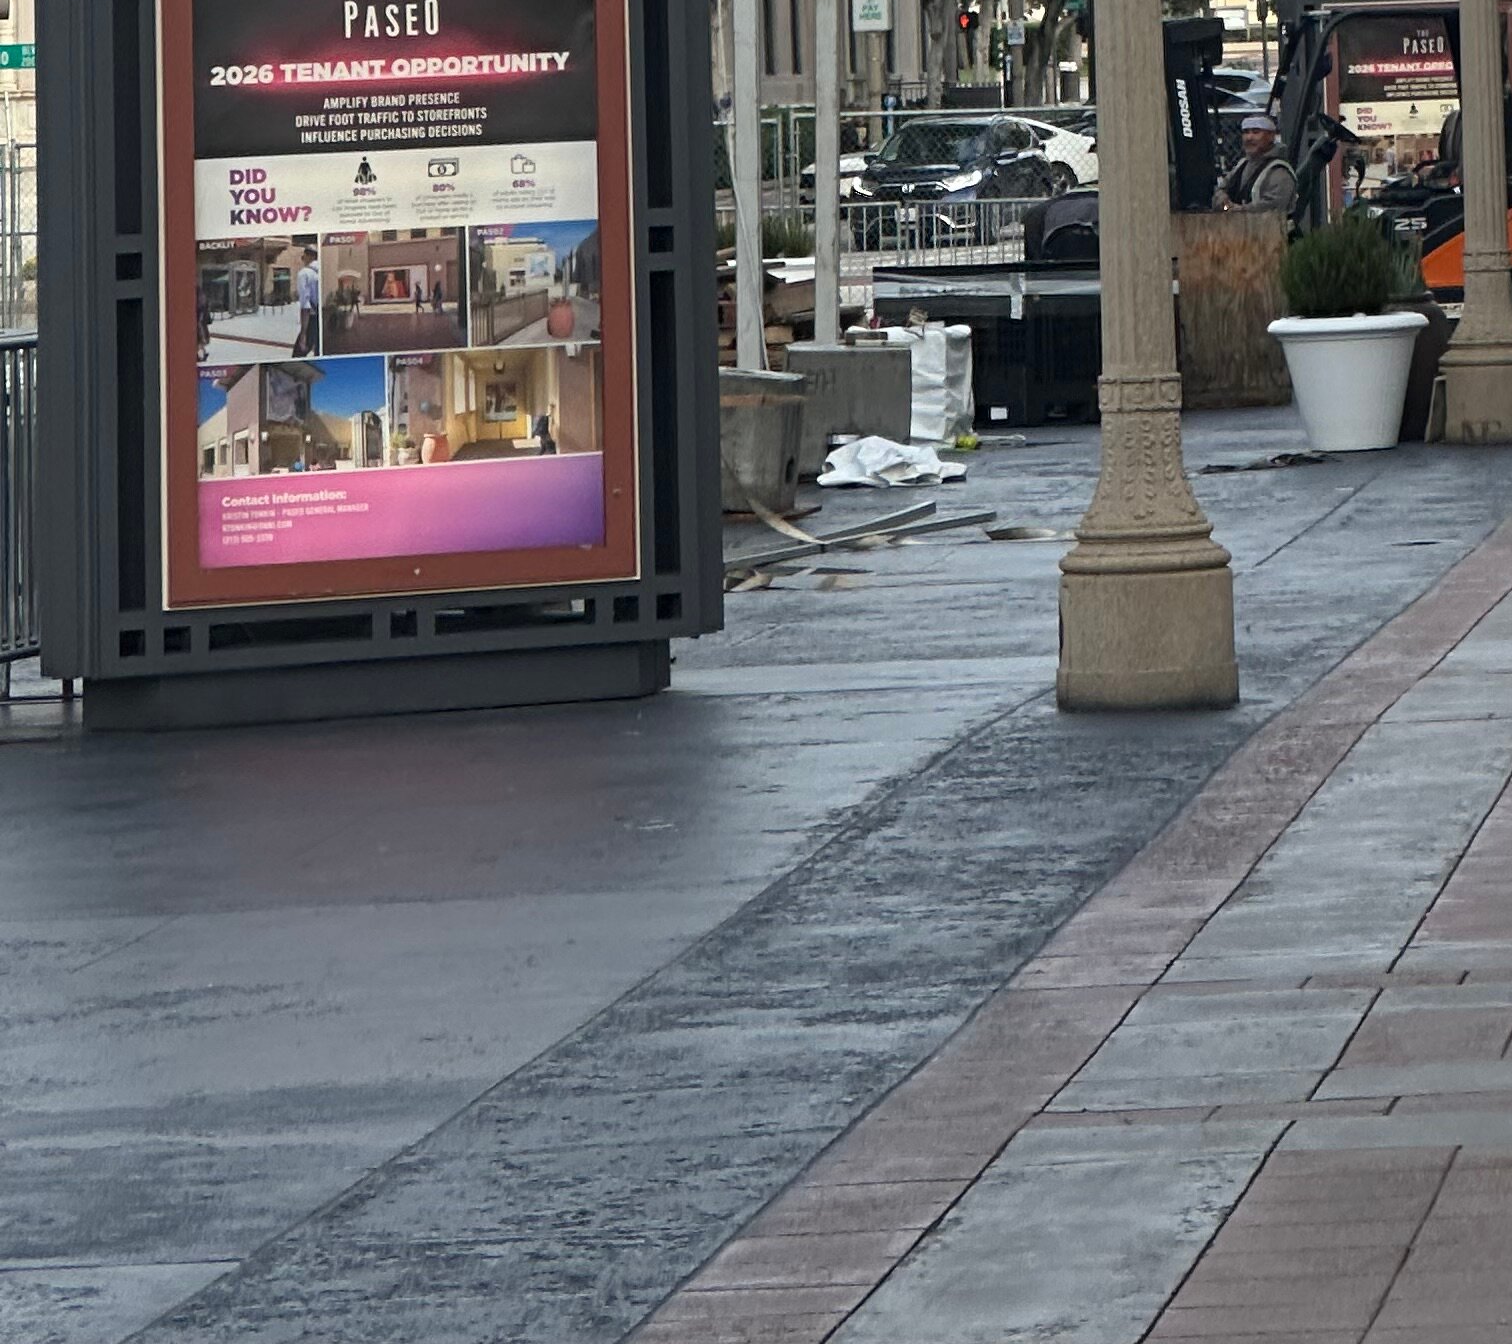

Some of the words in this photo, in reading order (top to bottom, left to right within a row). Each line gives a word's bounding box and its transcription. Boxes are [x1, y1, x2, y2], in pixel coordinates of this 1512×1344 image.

[1403, 36, 1444, 54] PASEO
[210, 64, 274, 86] 2026
[279, 59, 386, 83] TENANT
[391, 51, 570, 77] OPPORTUNITY
[323, 96, 368, 110] AMPLIFY
[371, 94, 405, 108] BRAND
[408, 91, 460, 106] PRESENCE
[1175, 78, 1193, 138] DOOSAN
[295, 114, 326, 128] DRIVE
[328, 112, 355, 126] FOOT
[357, 111, 399, 125] TRAFFIC
[402, 109, 414, 123] TO
[416, 107, 487, 122] STOREFRONTS
[300, 129, 358, 144] INFLUENCE
[360, 126, 426, 142] PURCHASING
[428, 124, 482, 138] DECISIONS
[229, 168, 267, 185] DID
[229, 188, 276, 205] YOU
[229, 206, 313, 226] KNOW?
[1394, 217, 1428, 231] 25
[199, 241, 236, 251] BACKLIT
[222, 495, 269, 508] Contact
[272, 490, 347, 504] Information:
